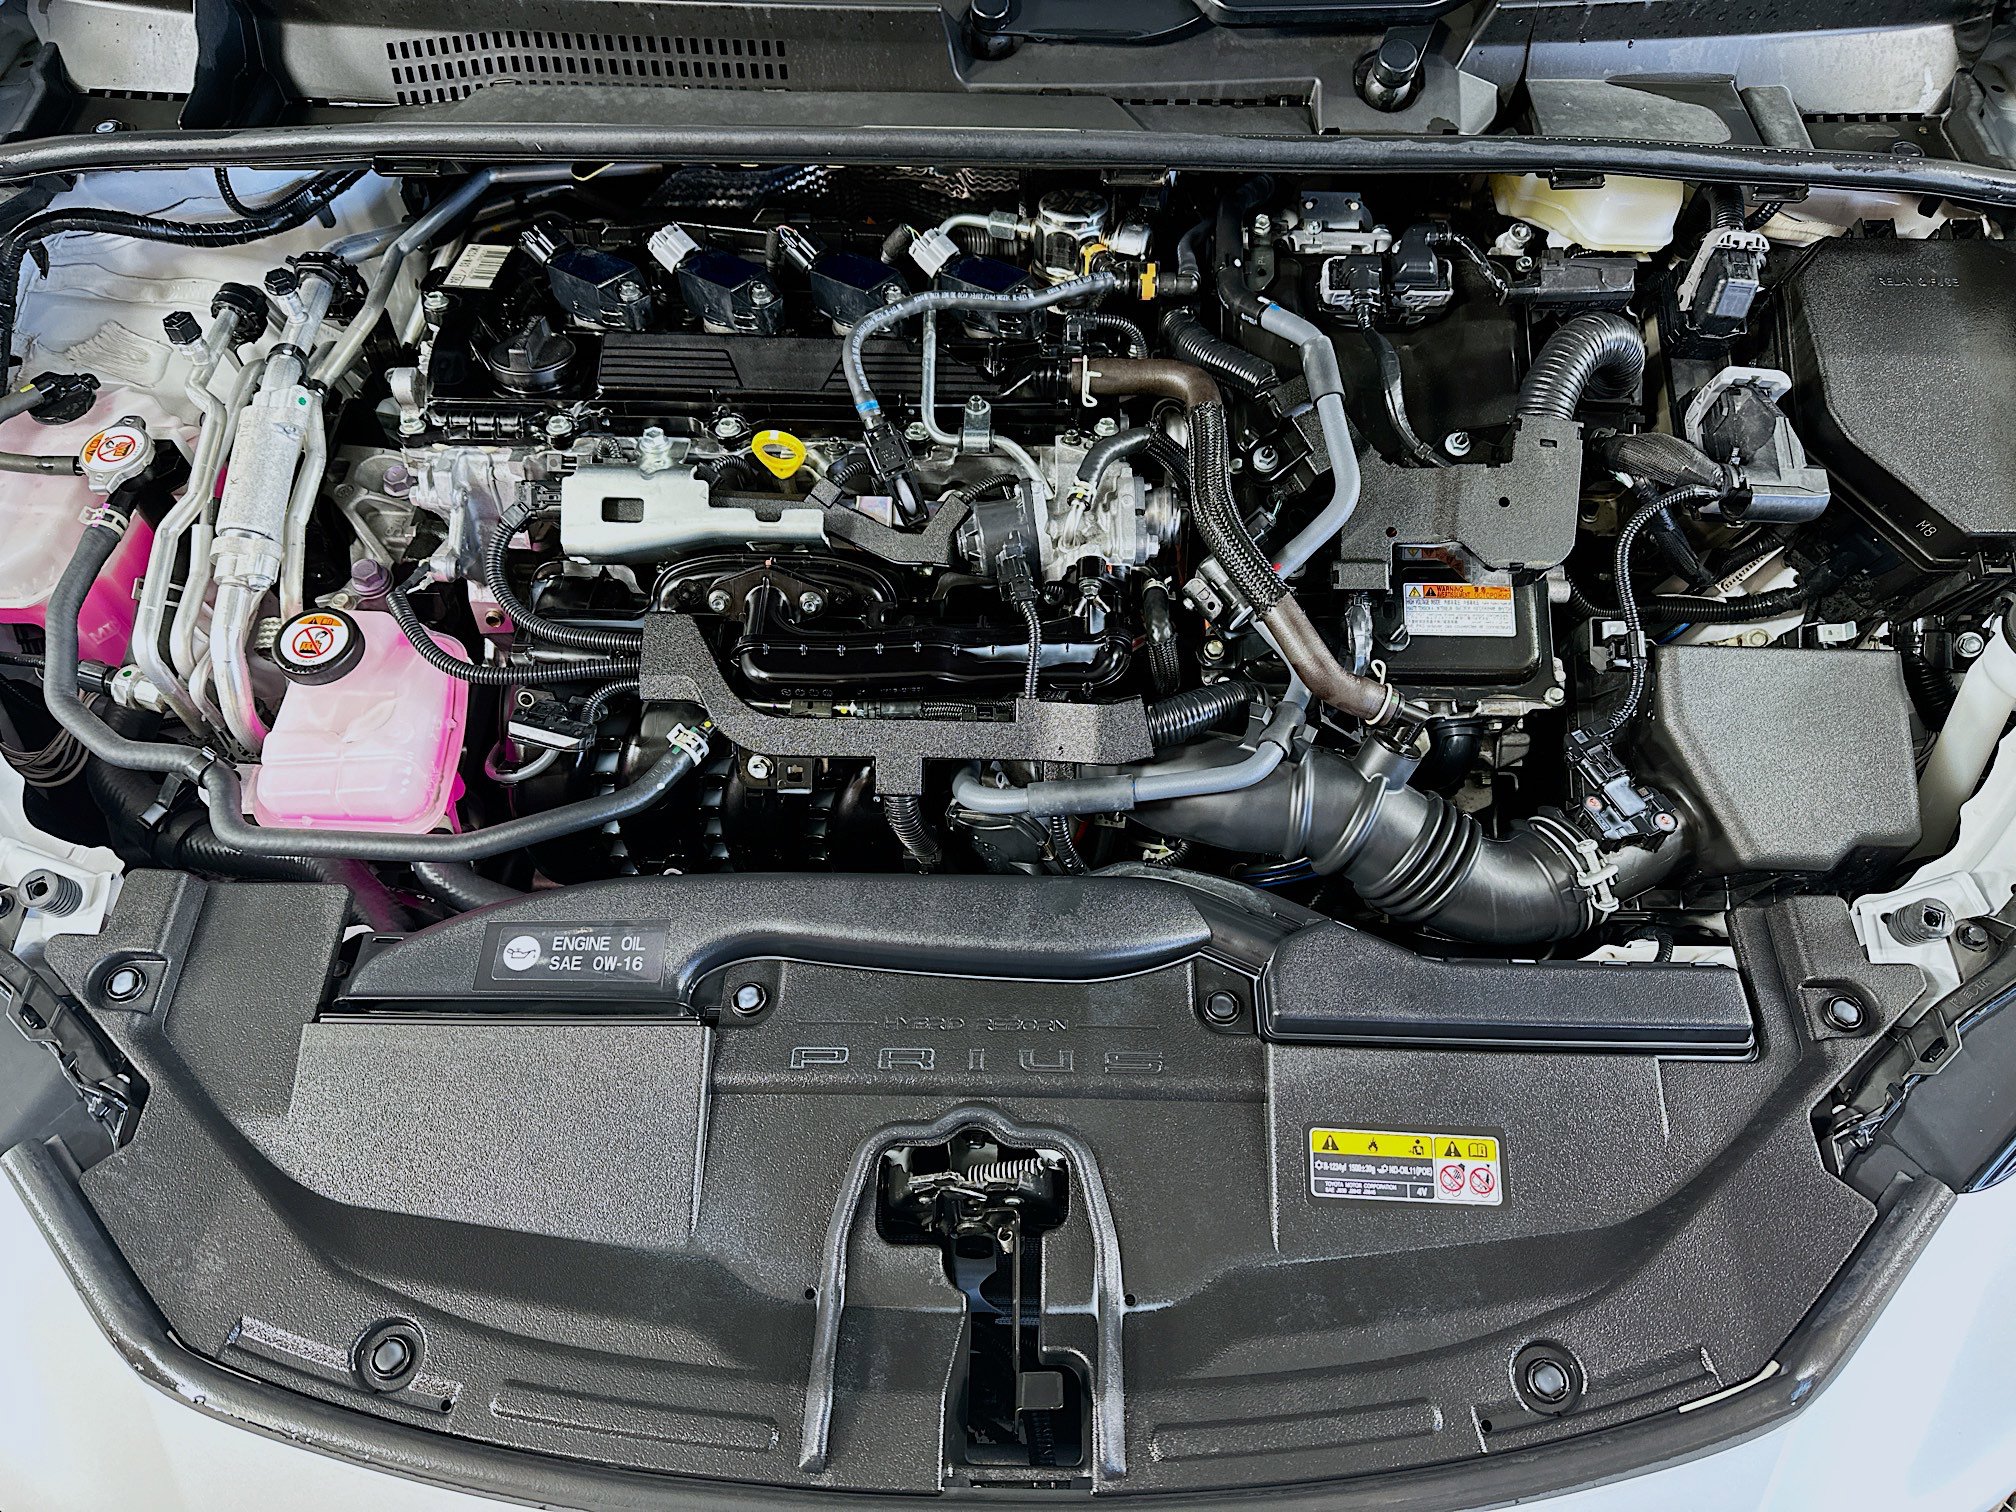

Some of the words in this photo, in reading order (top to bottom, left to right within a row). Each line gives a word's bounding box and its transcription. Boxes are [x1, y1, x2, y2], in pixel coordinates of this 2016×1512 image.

[1878, 277, 1914, 287] RELAY
[1915, 520, 1937, 537] M8
[551, 936, 612, 951] ENGINE
[621, 936, 646, 951] OIL
[548, 956, 583, 971] SAE
[789, 1046, 1164, 1074] PRIUS
[1363, 1182, 1397, 1191] CORPORATION
[1416, 1187, 1428, 1197] 4V
